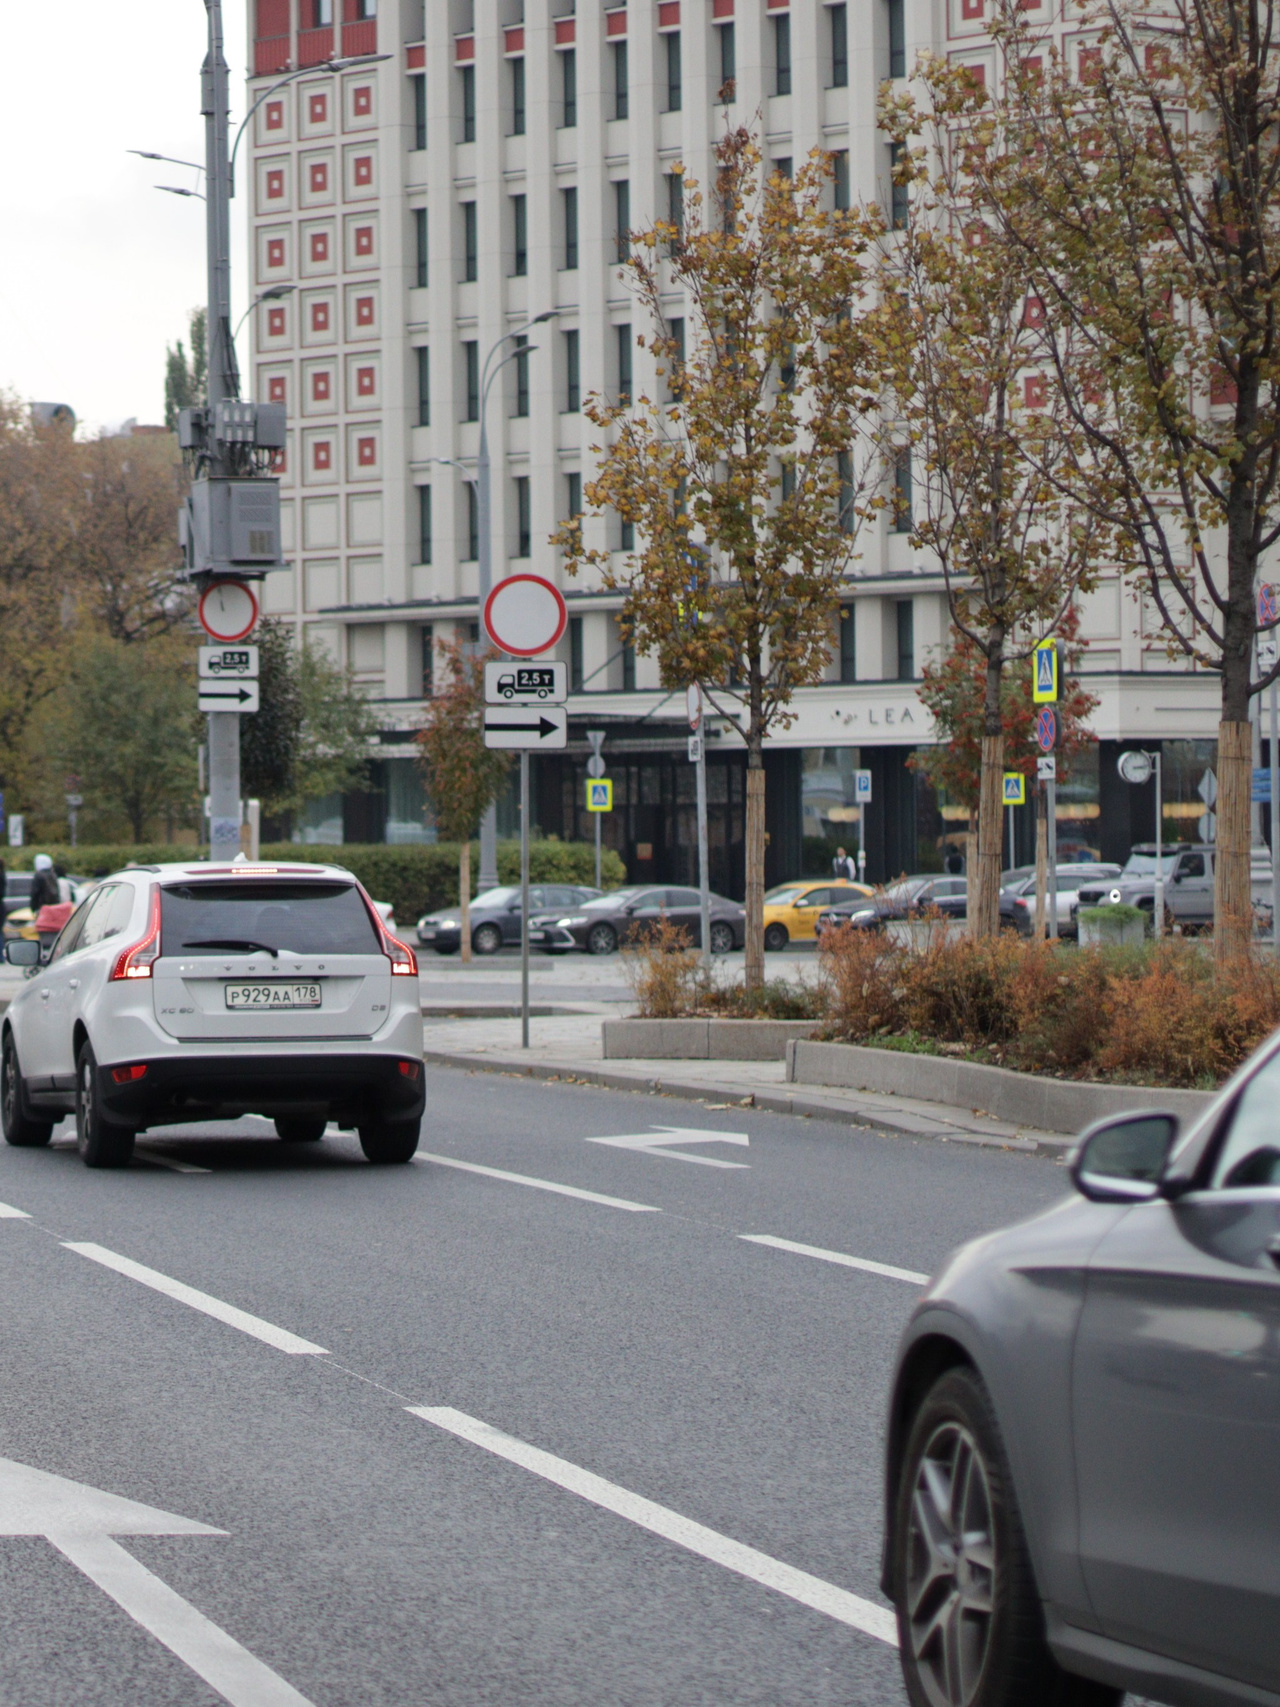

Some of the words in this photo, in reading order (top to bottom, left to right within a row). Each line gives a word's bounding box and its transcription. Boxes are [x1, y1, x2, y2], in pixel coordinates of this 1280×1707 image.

[520, 671, 541, 686] 2,5
[223, 963, 326, 972] VOLVO
[294, 986, 317, 999] 178
